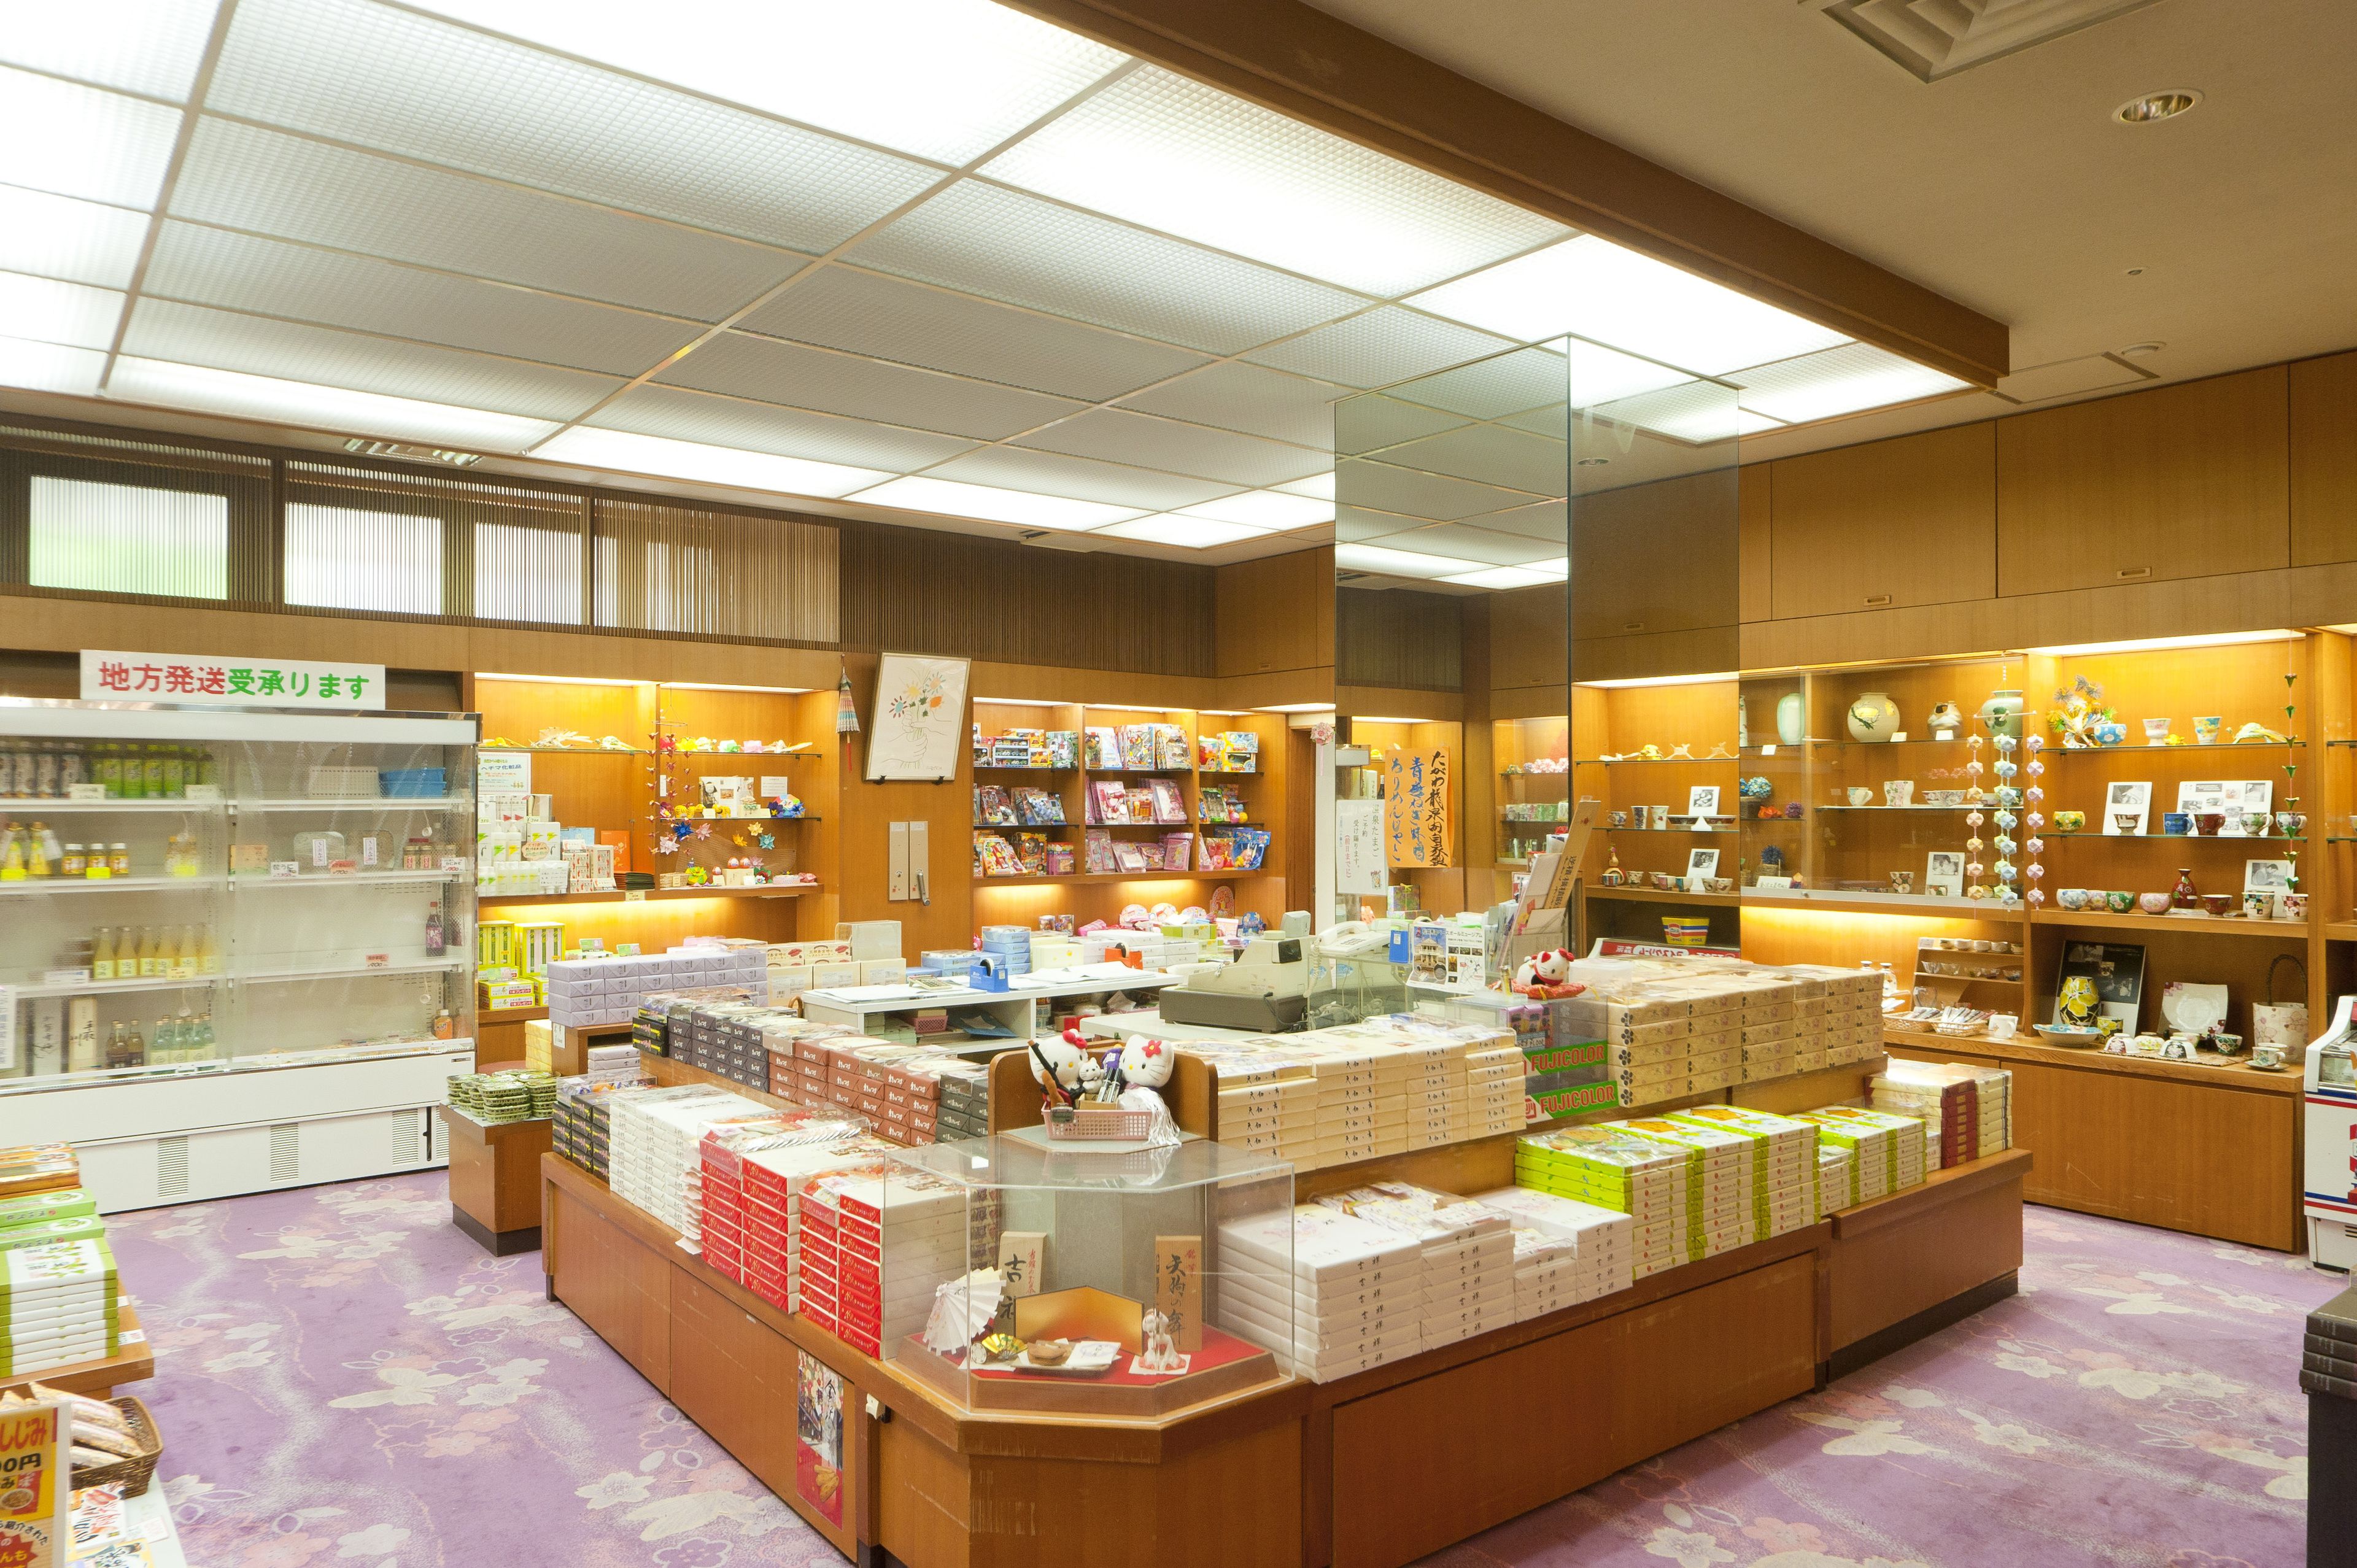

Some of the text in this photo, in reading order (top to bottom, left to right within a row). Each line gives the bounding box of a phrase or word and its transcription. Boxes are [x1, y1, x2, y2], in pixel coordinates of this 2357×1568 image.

[99, 661, 370, 700] 地方発送受承ります
[1531, 1045, 1604, 1072] FUJICOLOR
[1539, 1085, 1615, 1114] FUJICOLOR
[1166, 1254, 1186, 1345] 天狗の舞
[0, 1453, 41, 1472] 0円
